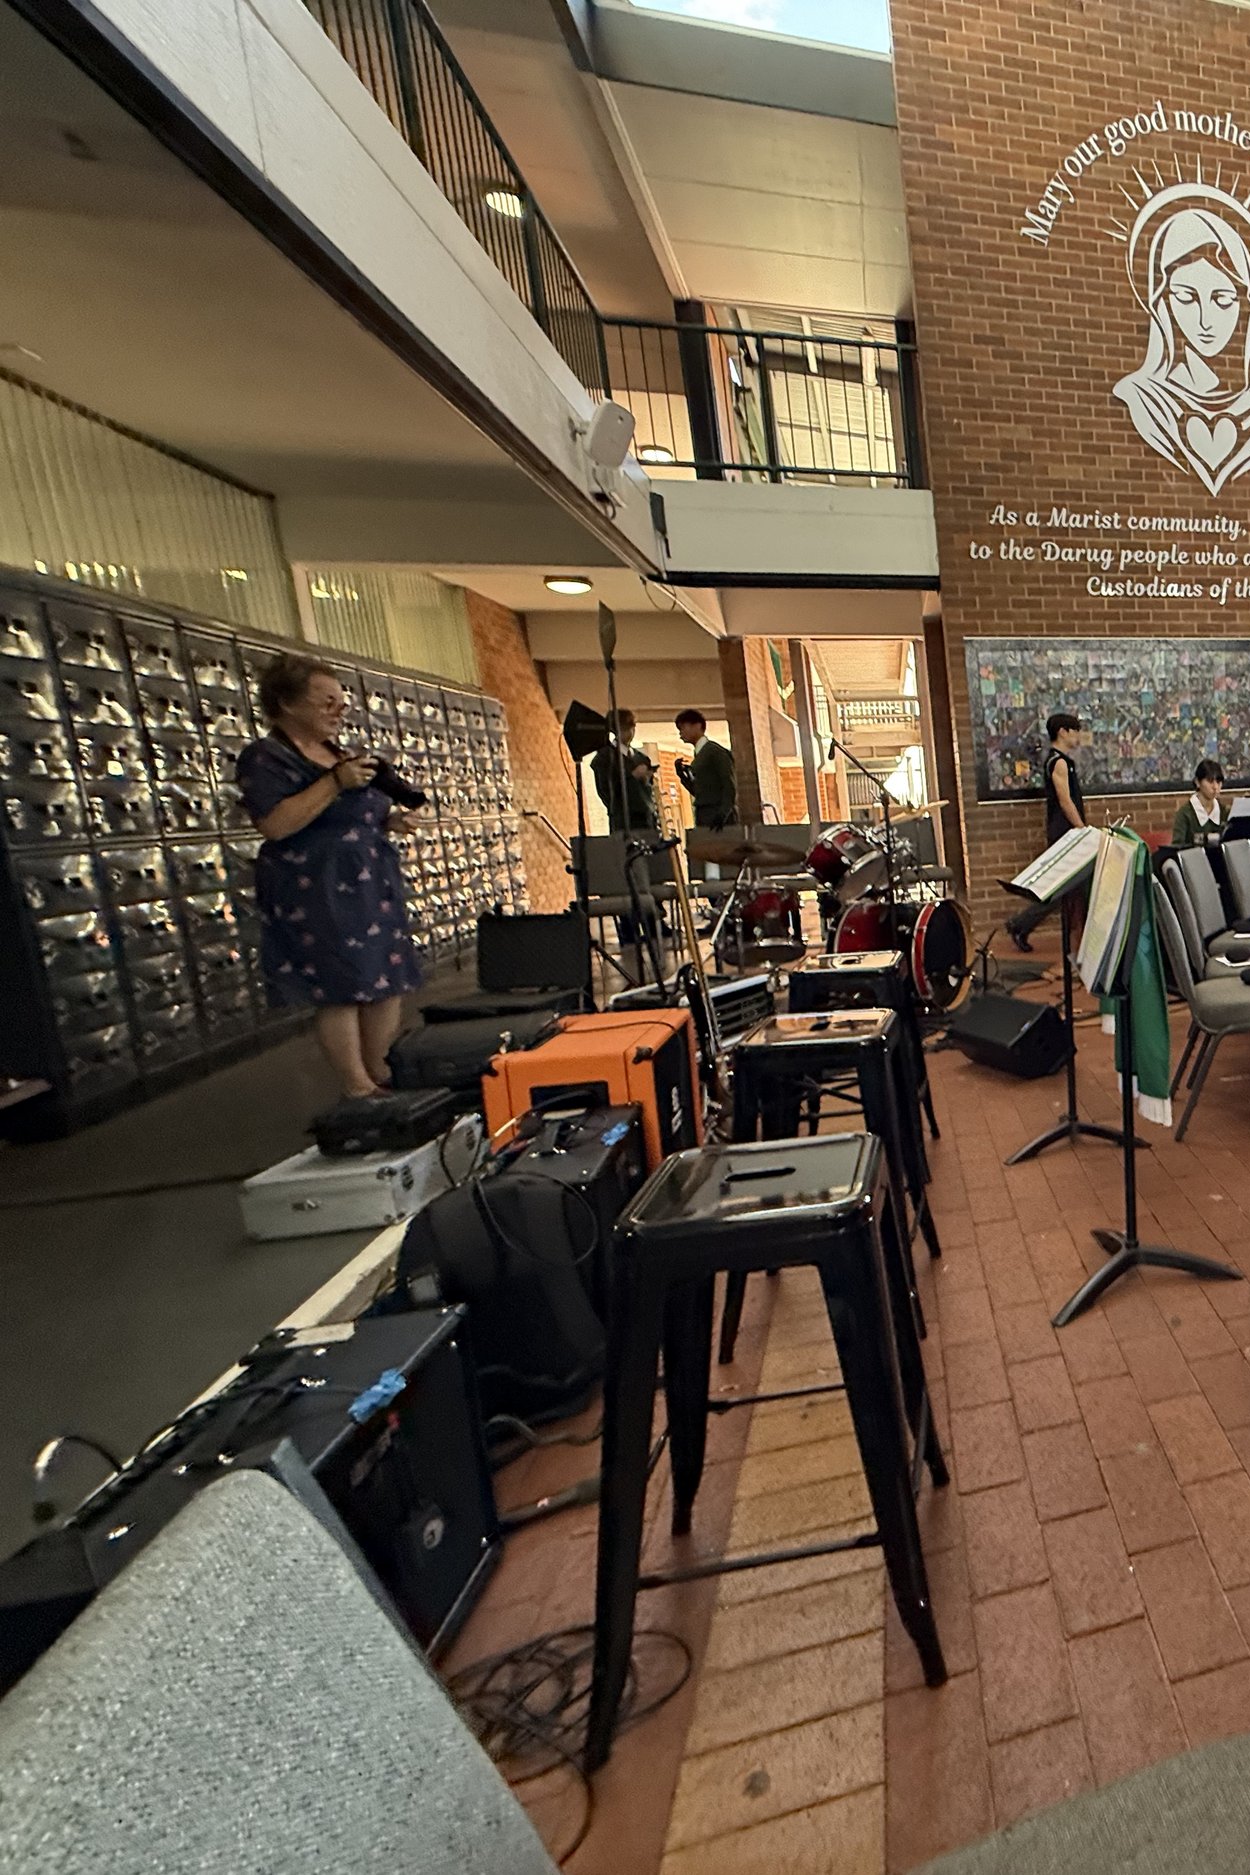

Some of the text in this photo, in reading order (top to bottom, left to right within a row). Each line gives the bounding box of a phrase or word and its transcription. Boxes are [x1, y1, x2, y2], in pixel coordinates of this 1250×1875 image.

[1020, 169, 1075, 247] Mary
[1064, 133, 1104, 177] our
[1104, 99, 1169, 156] good
[989, 504, 1018, 526] As
[1025, 510, 1040, 527] a
[1046, 507, 1122, 530] Marist
[1127, 515, 1247, 542] community,
[969, 541, 994, 560] to
[999, 538, 1036, 561] the
[1041, 541, 1115, 571] Darug
[1119, 544, 1190, 572] people
[1194, 545, 1238, 567] who
[1086, 576, 1204, 598] Custodians
[1209, 577, 1232, 605] of
